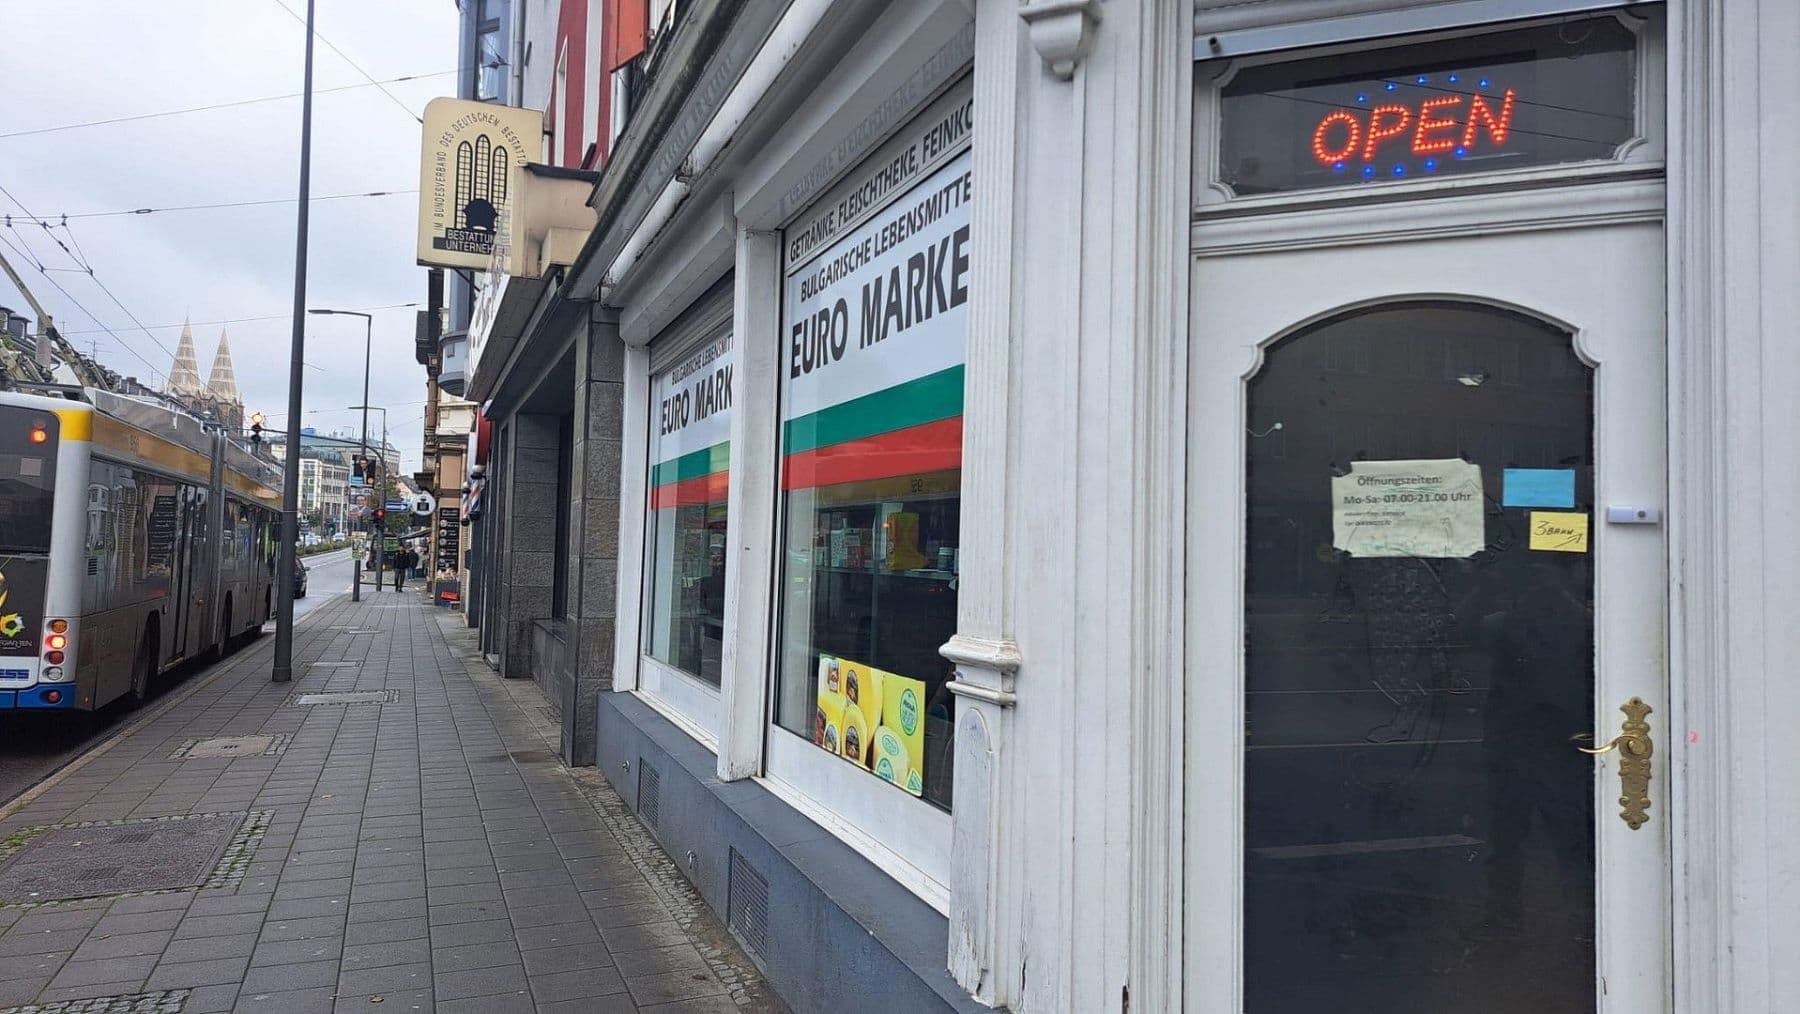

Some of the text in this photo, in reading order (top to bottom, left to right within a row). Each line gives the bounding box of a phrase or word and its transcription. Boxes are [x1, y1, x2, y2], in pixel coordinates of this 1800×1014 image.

[440, 131, 454, 147] DES
[452, 112, 501, 132] DEUTSCHEN
[1312, 88, 1516, 165] OPEN
[433, 151, 447, 217] BUNDESVERBAND
[790, 211, 837, 262] GETRÄNKE,
[838, 144, 919, 228] FLEISCHTHEKE,
[433, 222, 443, 231] IM
[801, 238, 872, 303] BULGARISCHE
[874, 170, 972, 259] LEBENSMITTE
[790, 223, 970, 380] EURO MARKE
[671, 353, 702, 386] BULGARISCHE
[661, 363, 733, 436] EURO MARK
[1344, 492, 1472, 504] Mo-Sa: 07.00-21.00 Uhr
[1357, 475, 1443, 487] Öffnungszeiten:
